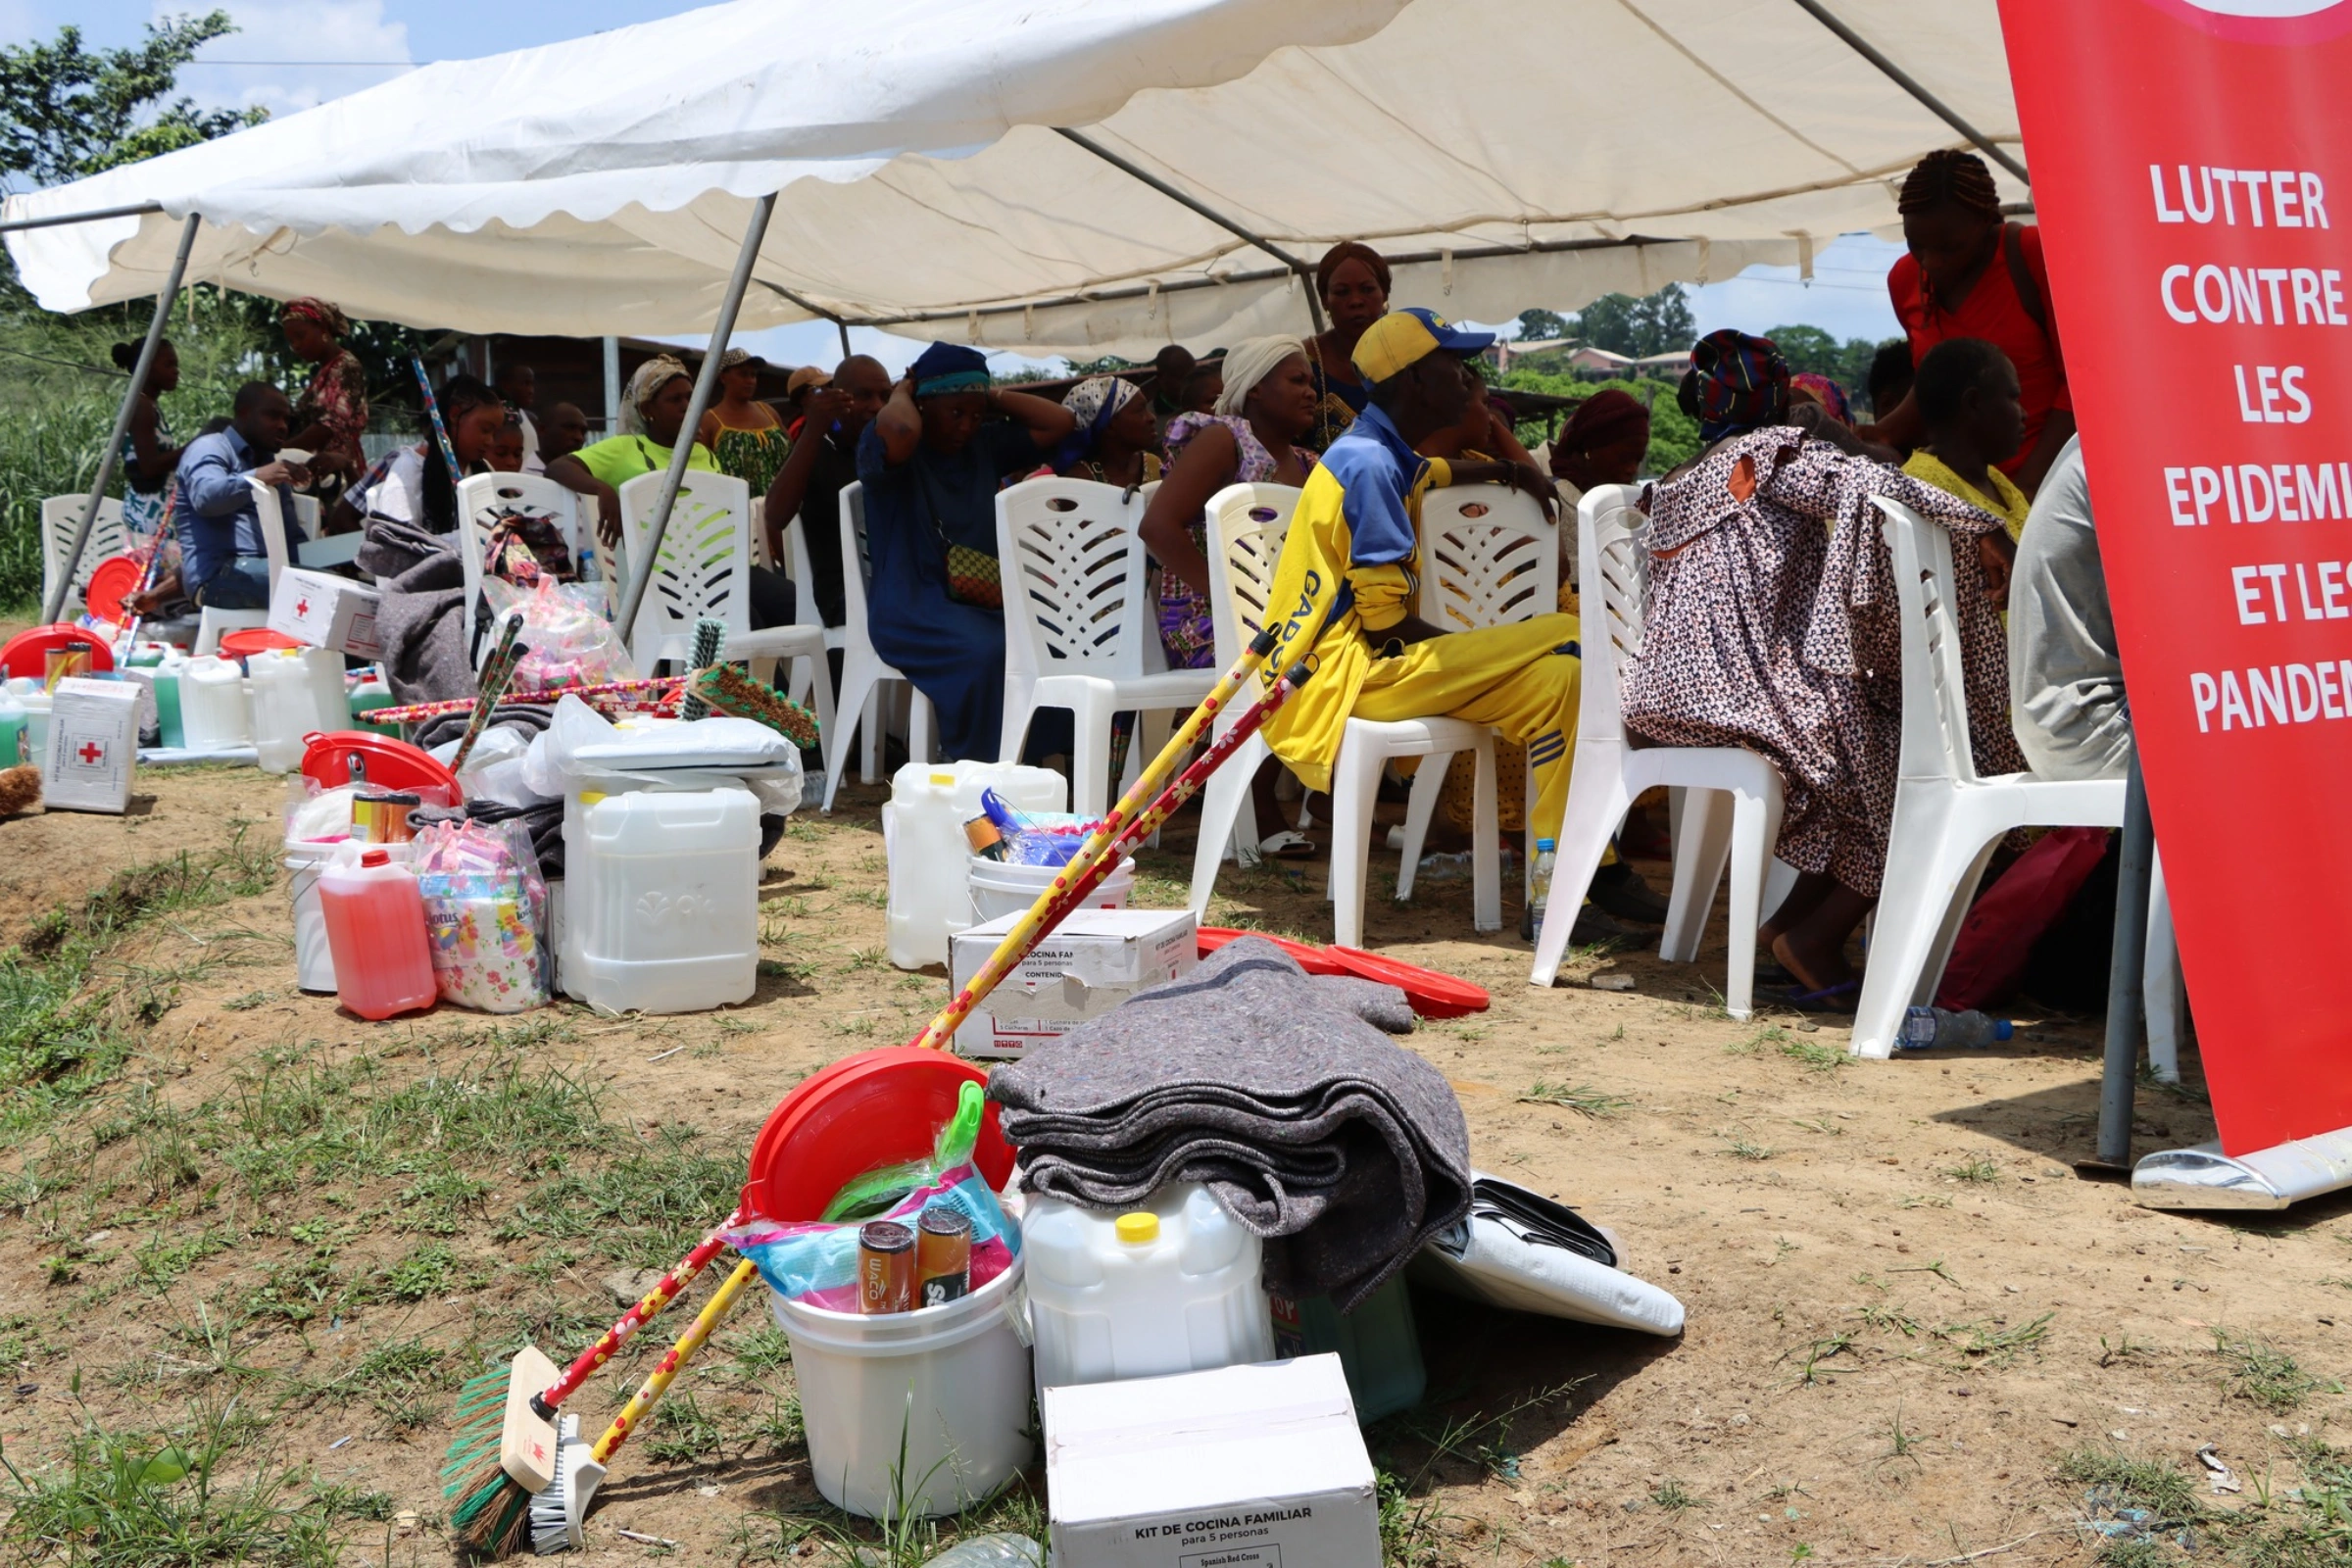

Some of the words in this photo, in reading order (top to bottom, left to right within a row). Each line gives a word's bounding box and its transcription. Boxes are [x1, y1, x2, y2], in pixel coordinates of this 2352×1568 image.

[2149, 165, 2329, 229] LUTTER
[2160, 264, 2348, 325] CONTRE
[2233, 365, 2312, 423] LES
[2230, 564, 2287, 625] ET
[868, 1258, 881, 1300] WACO
[1135, 1527, 1157, 1540] KIT
[1162, 1524, 1182, 1536] DE
[1186, 1516, 1241, 1533] COCINA
[1245, 1507, 1312, 1525] FAMILIAR
[1181, 1536, 1206, 1546] para
[1209, 1533, 1216, 1542] 5
[1220, 1527, 1269, 1542] personas
[1200, 1555, 1227, 1567] Spanish
[1227, 1553, 1241, 1563] Red
[1241, 1552, 1260, 1562] Cross
